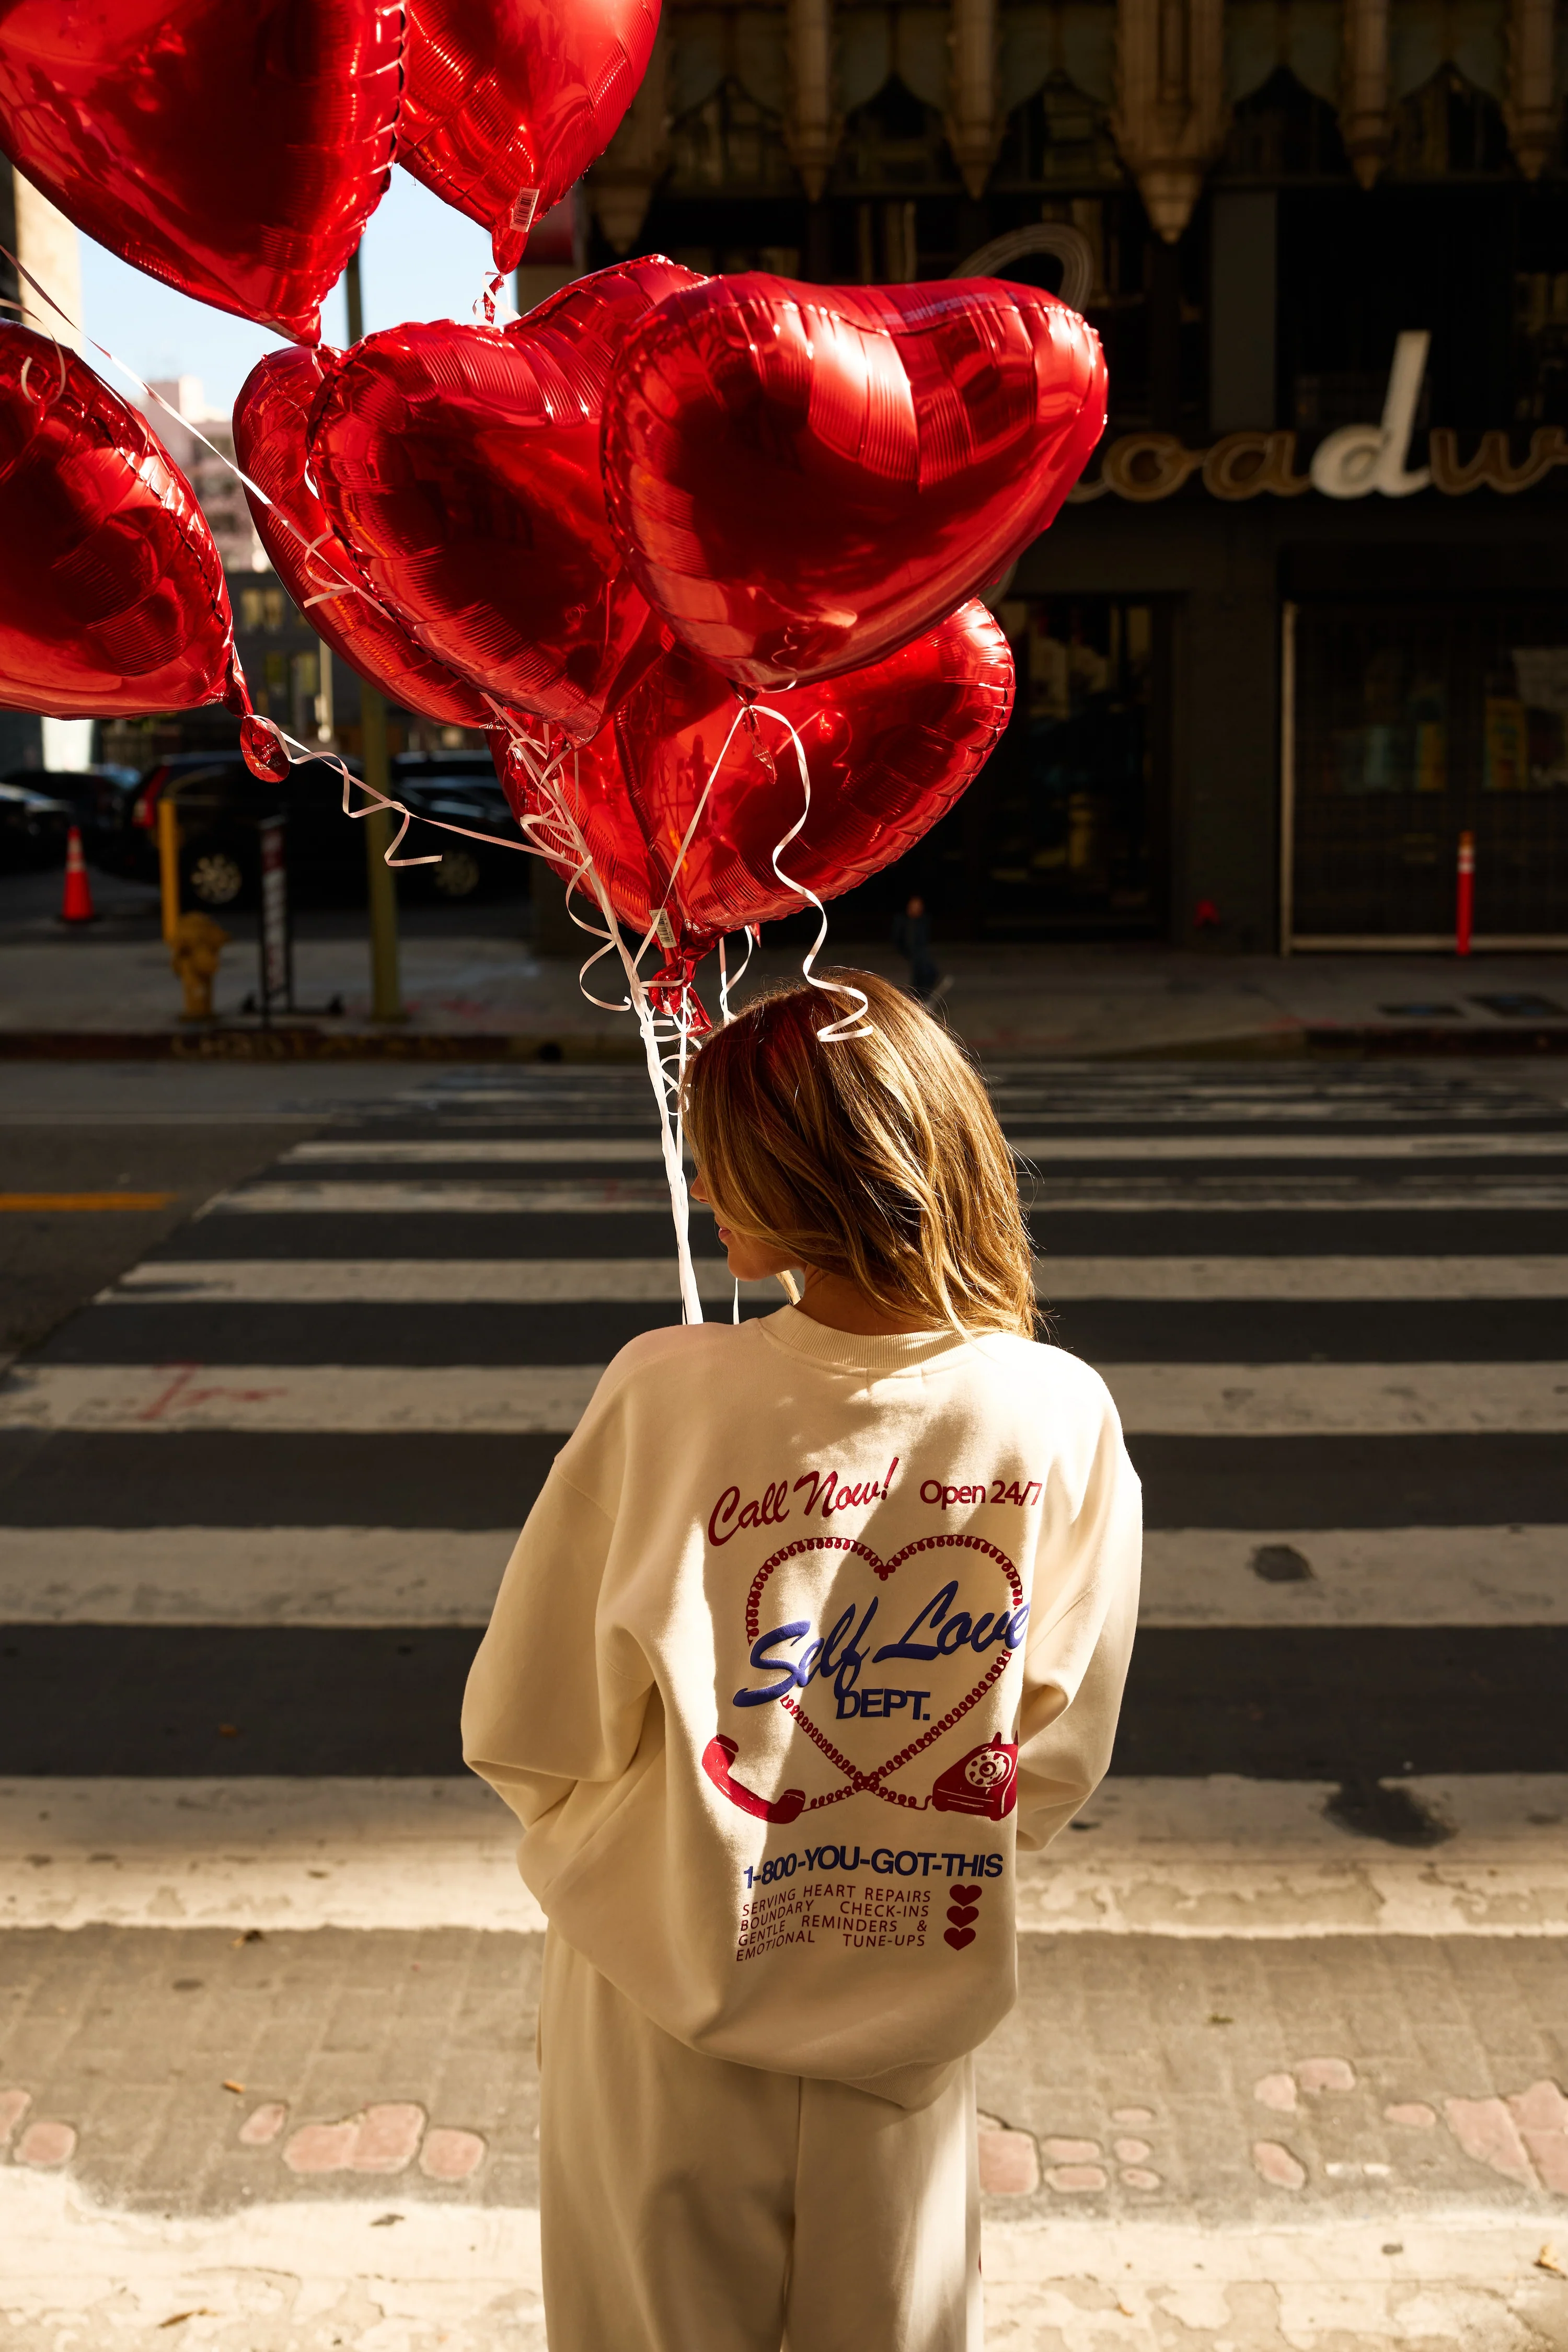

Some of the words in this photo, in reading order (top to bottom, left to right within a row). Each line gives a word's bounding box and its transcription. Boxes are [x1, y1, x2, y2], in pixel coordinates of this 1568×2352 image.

[708, 1480, 789, 1546] Call
[793, 1457, 900, 1518] Now!
[920, 1480, 986, 1510] Open
[990, 1480, 1042, 1506] 24/7
[733, 1596, 879, 1707] Self
[872, 1581, 1030, 1663] Love
[836, 1689, 930, 1720] DEPT.
[744, 1846, 1003, 1888] 1-800-YOU-GOT-THIS
[741, 1900, 814, 1931] BOUNDARY
[840, 1900, 929, 1917] CHECK-INS
[742, 1888, 796, 1916] SERVING
[803, 1884, 856, 1898] HEART
[865, 1888, 931, 1903] REPAIRS
[739, 1920, 785, 1946] GENTLE
[802, 1915, 897, 1932] REMINDERS
[917, 1920, 927, 1932] &
[736, 1931, 815, 1962] EMOTIONAL
[843, 1934, 926, 1947] TUNE-UPS
